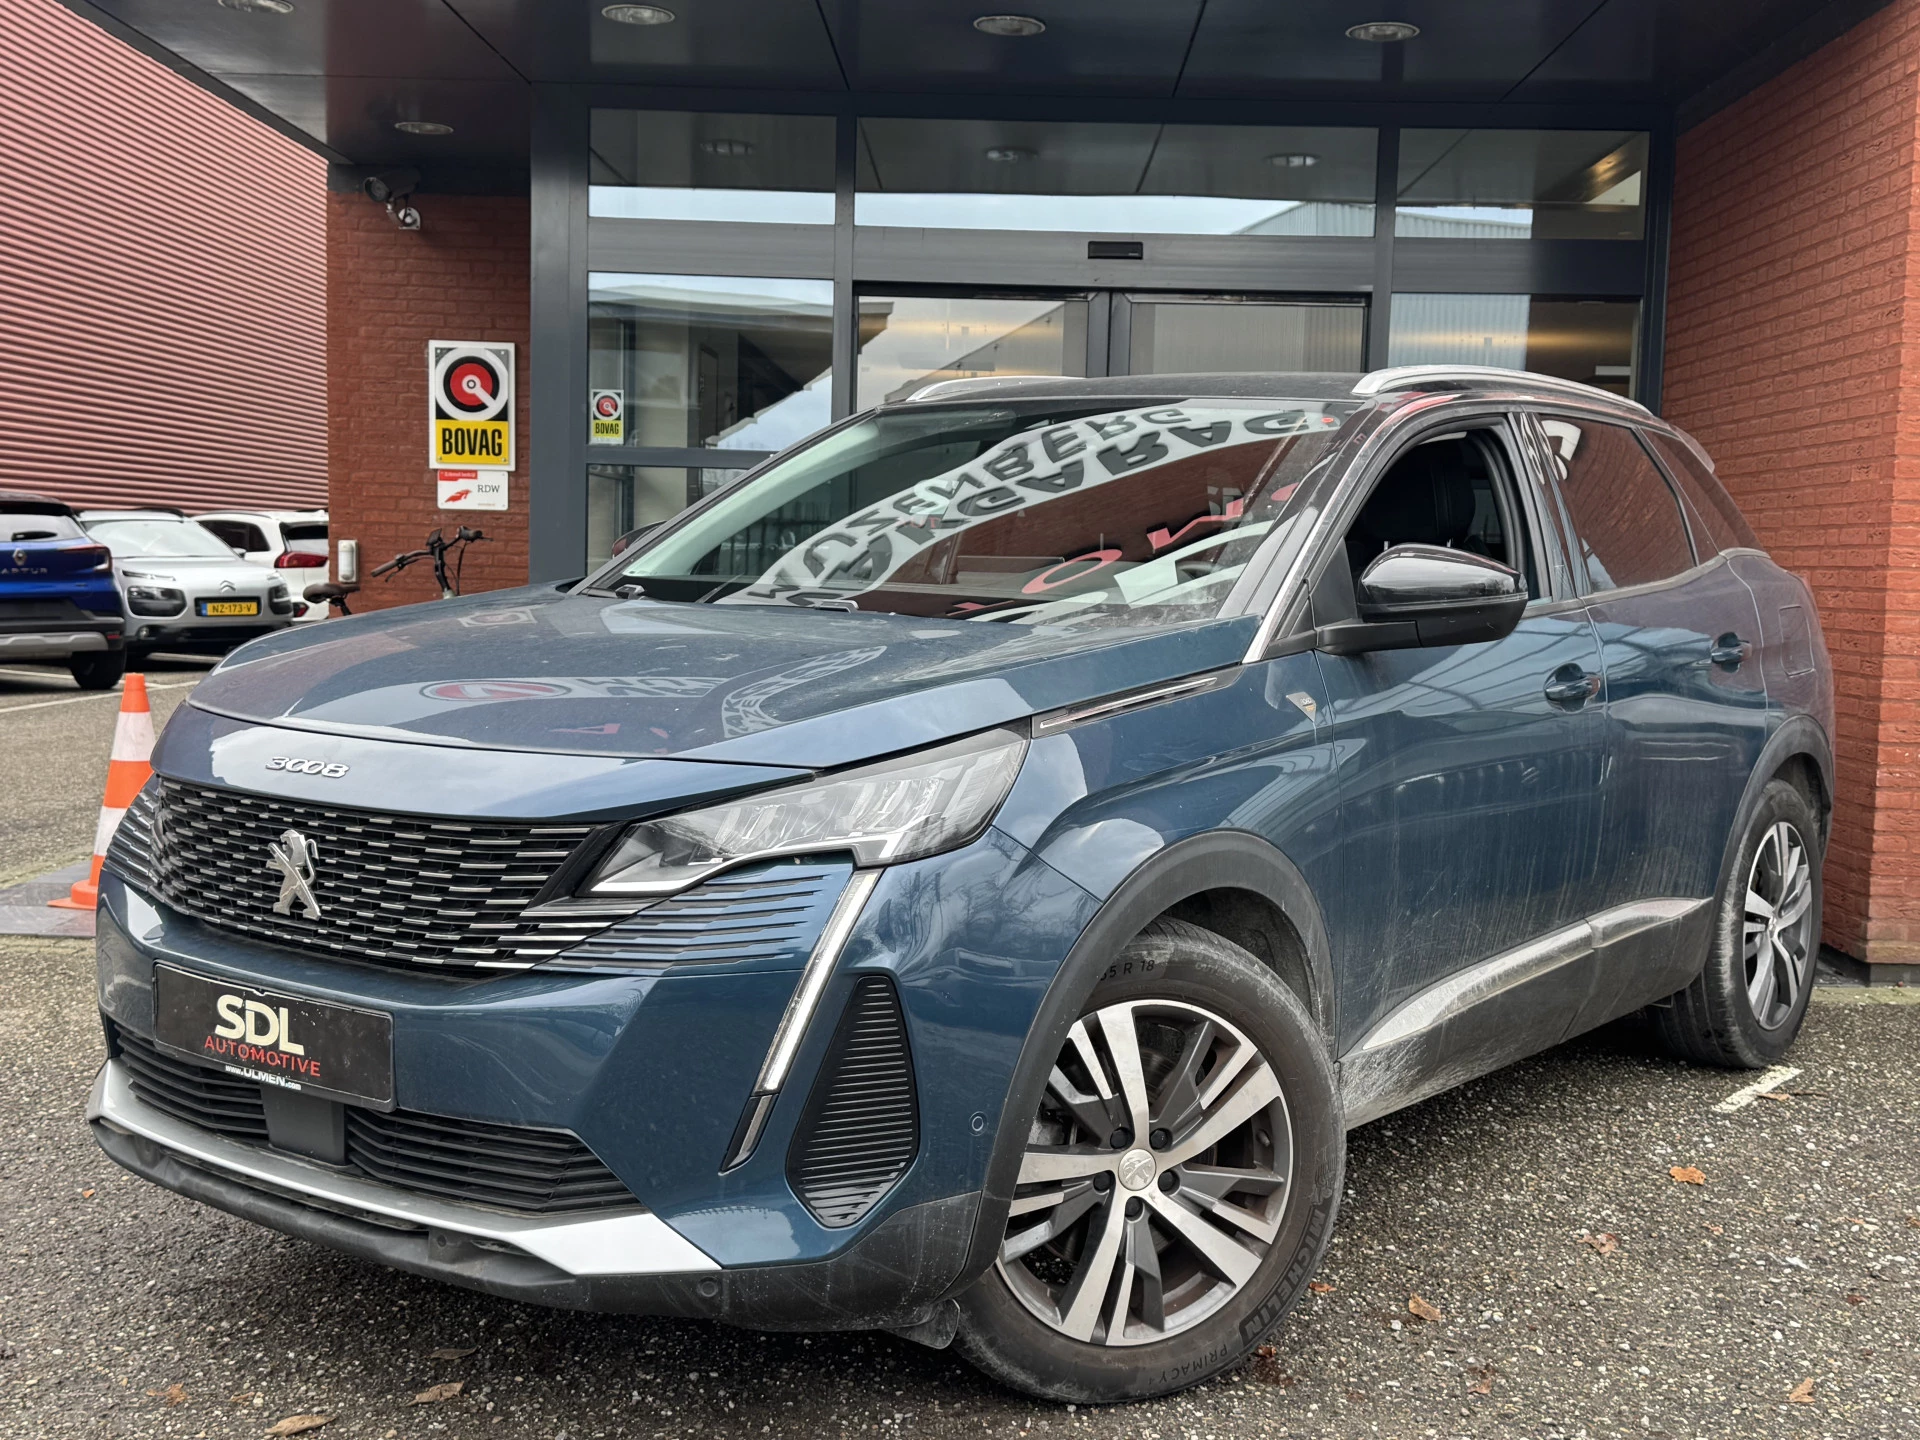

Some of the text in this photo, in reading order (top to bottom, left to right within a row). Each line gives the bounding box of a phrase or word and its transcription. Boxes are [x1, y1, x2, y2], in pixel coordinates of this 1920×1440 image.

[441, 427, 503, 457] BOVAG
[595, 422, 619, 435] BOVAG
[477, 484, 500, 494] RDW
[212, 603, 252, 613] NZ-173-V
[265, 756, 350, 778] 3008
[1123, 962, 1133, 974] R
[1140, 959, 1155, 972] 18
[214, 994, 305, 1056] SDL
[203, 1034, 322, 1078] AUTOMOTIVE
[225, 1064, 302, 1091] www.ULMEN.com
[1246, 1207, 1328, 1340] MICHELIN
[1159, 1343, 1228, 1384] PRIMACY
